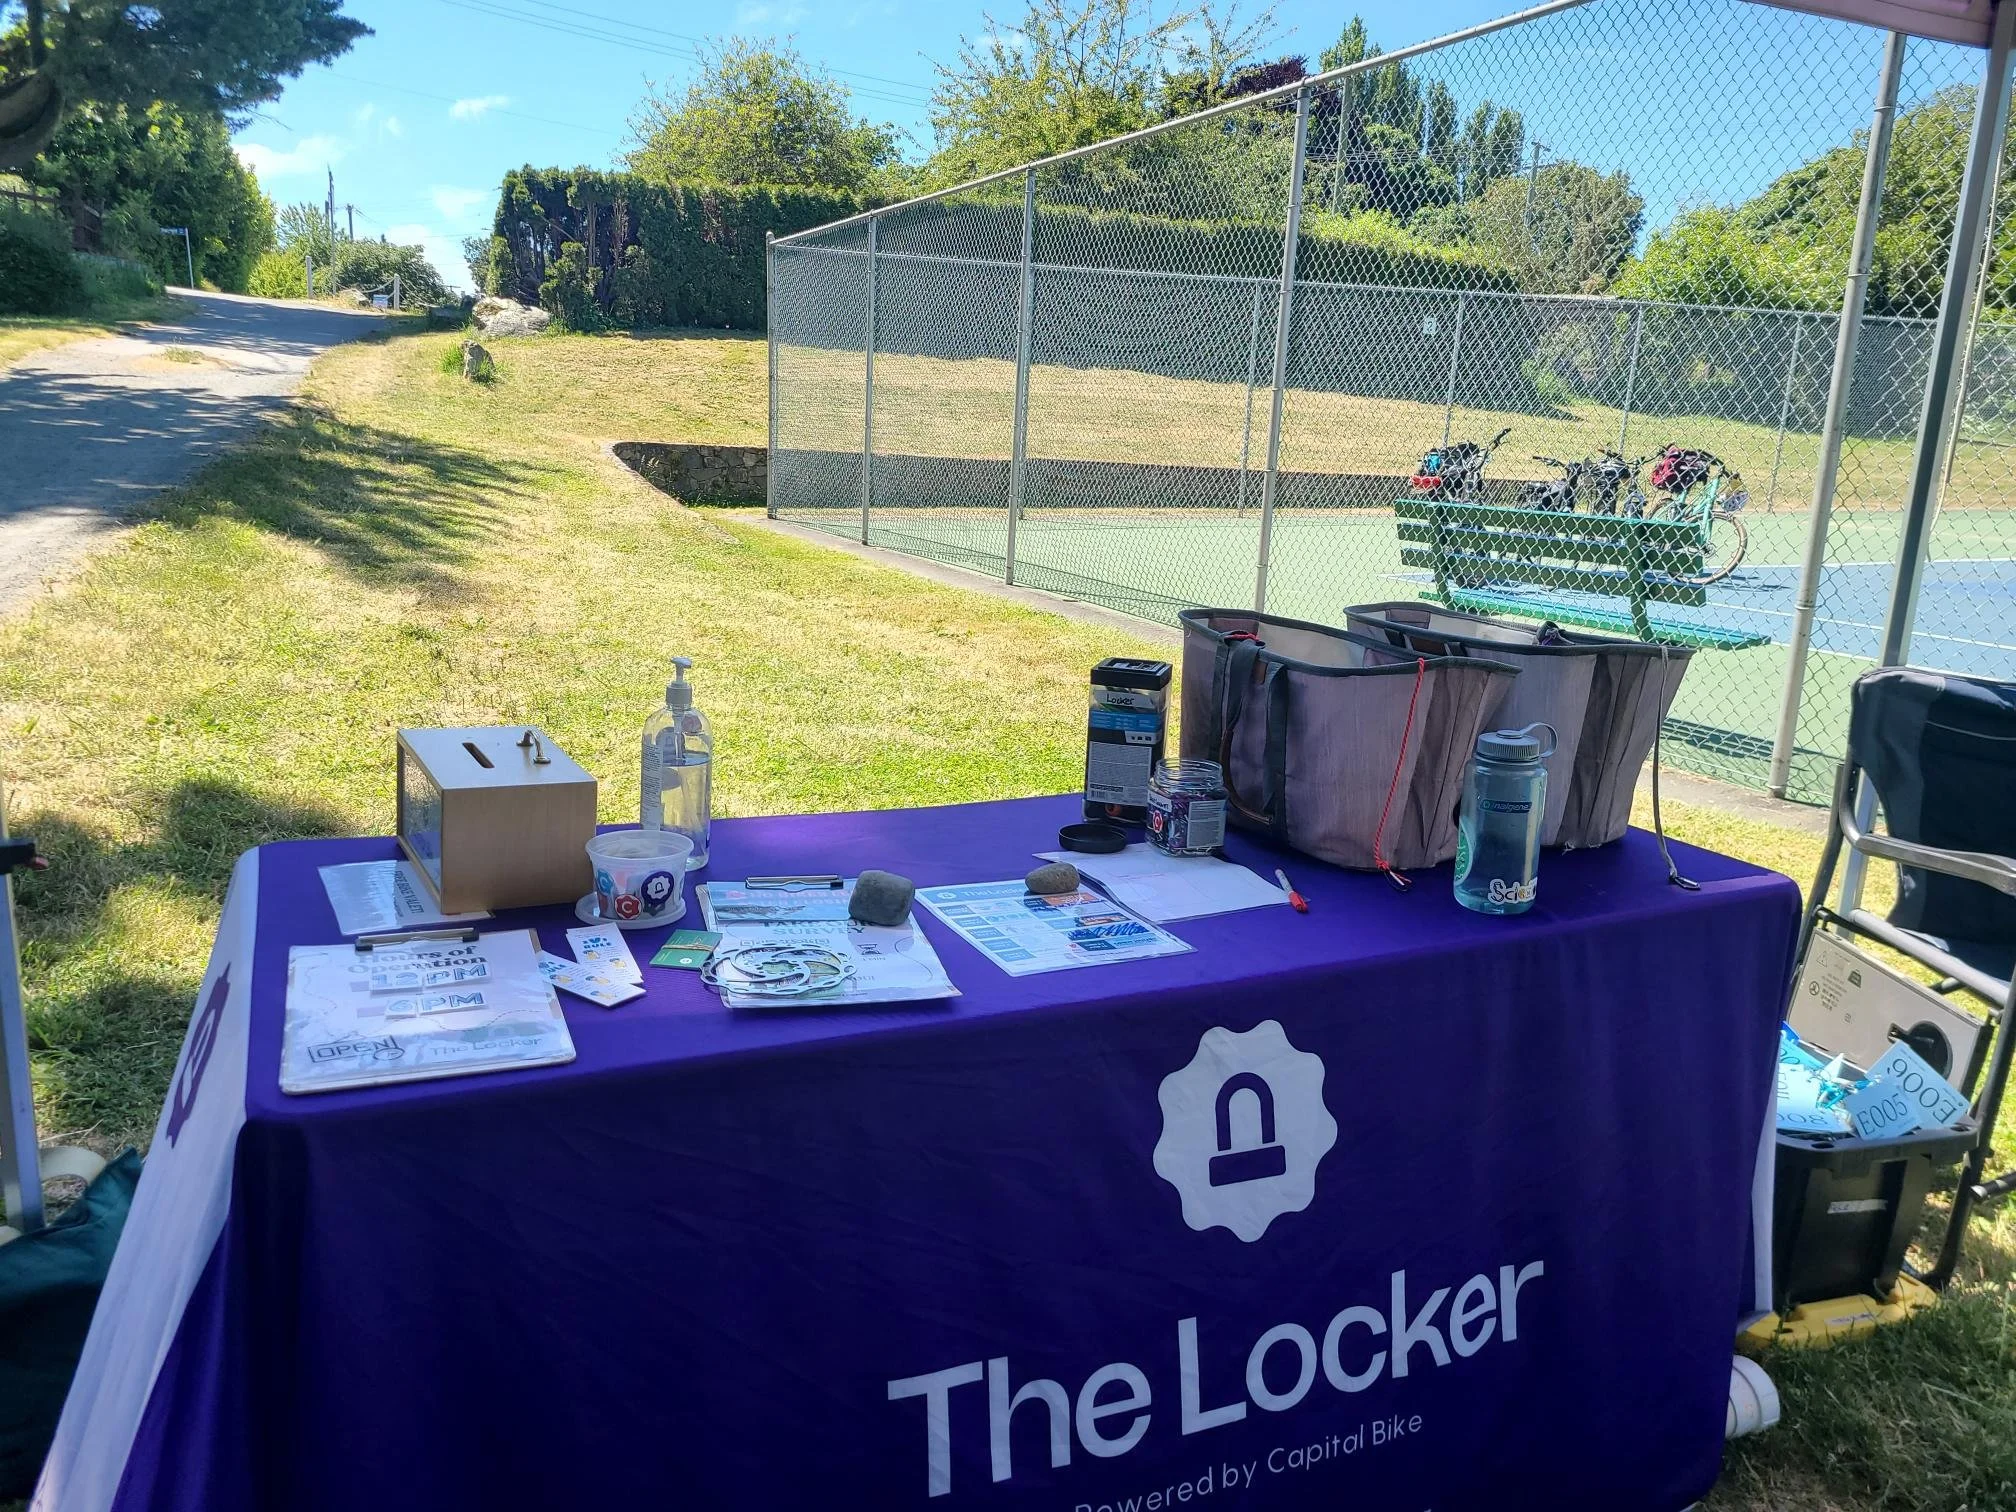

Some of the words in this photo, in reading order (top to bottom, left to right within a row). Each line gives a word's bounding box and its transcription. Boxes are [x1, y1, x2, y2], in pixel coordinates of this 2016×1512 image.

[773, 928, 865, 936] SURVEY
[360, 951, 442, 963] Hours
[448, 946, 477, 956] of
[348, 957, 488, 973] Operation
[372, 972, 418, 985] 12
[427, 964, 487, 985] PM
[421, 992, 484, 1011] PM
[317, 1039, 390, 1058] OPEN
[430, 1046, 468, 1056] The
[1856, 1093, 1908, 1136] E005
[888, 1356, 1152, 1497] The
[1178, 1260, 1544, 1435] Locker
[1075, 1466, 1213, 1512] wered
[1222, 1461, 1257, 1489] by
[1267, 1423, 1364, 1471] Capital
[1372, 1414, 1422, 1446] Bike
